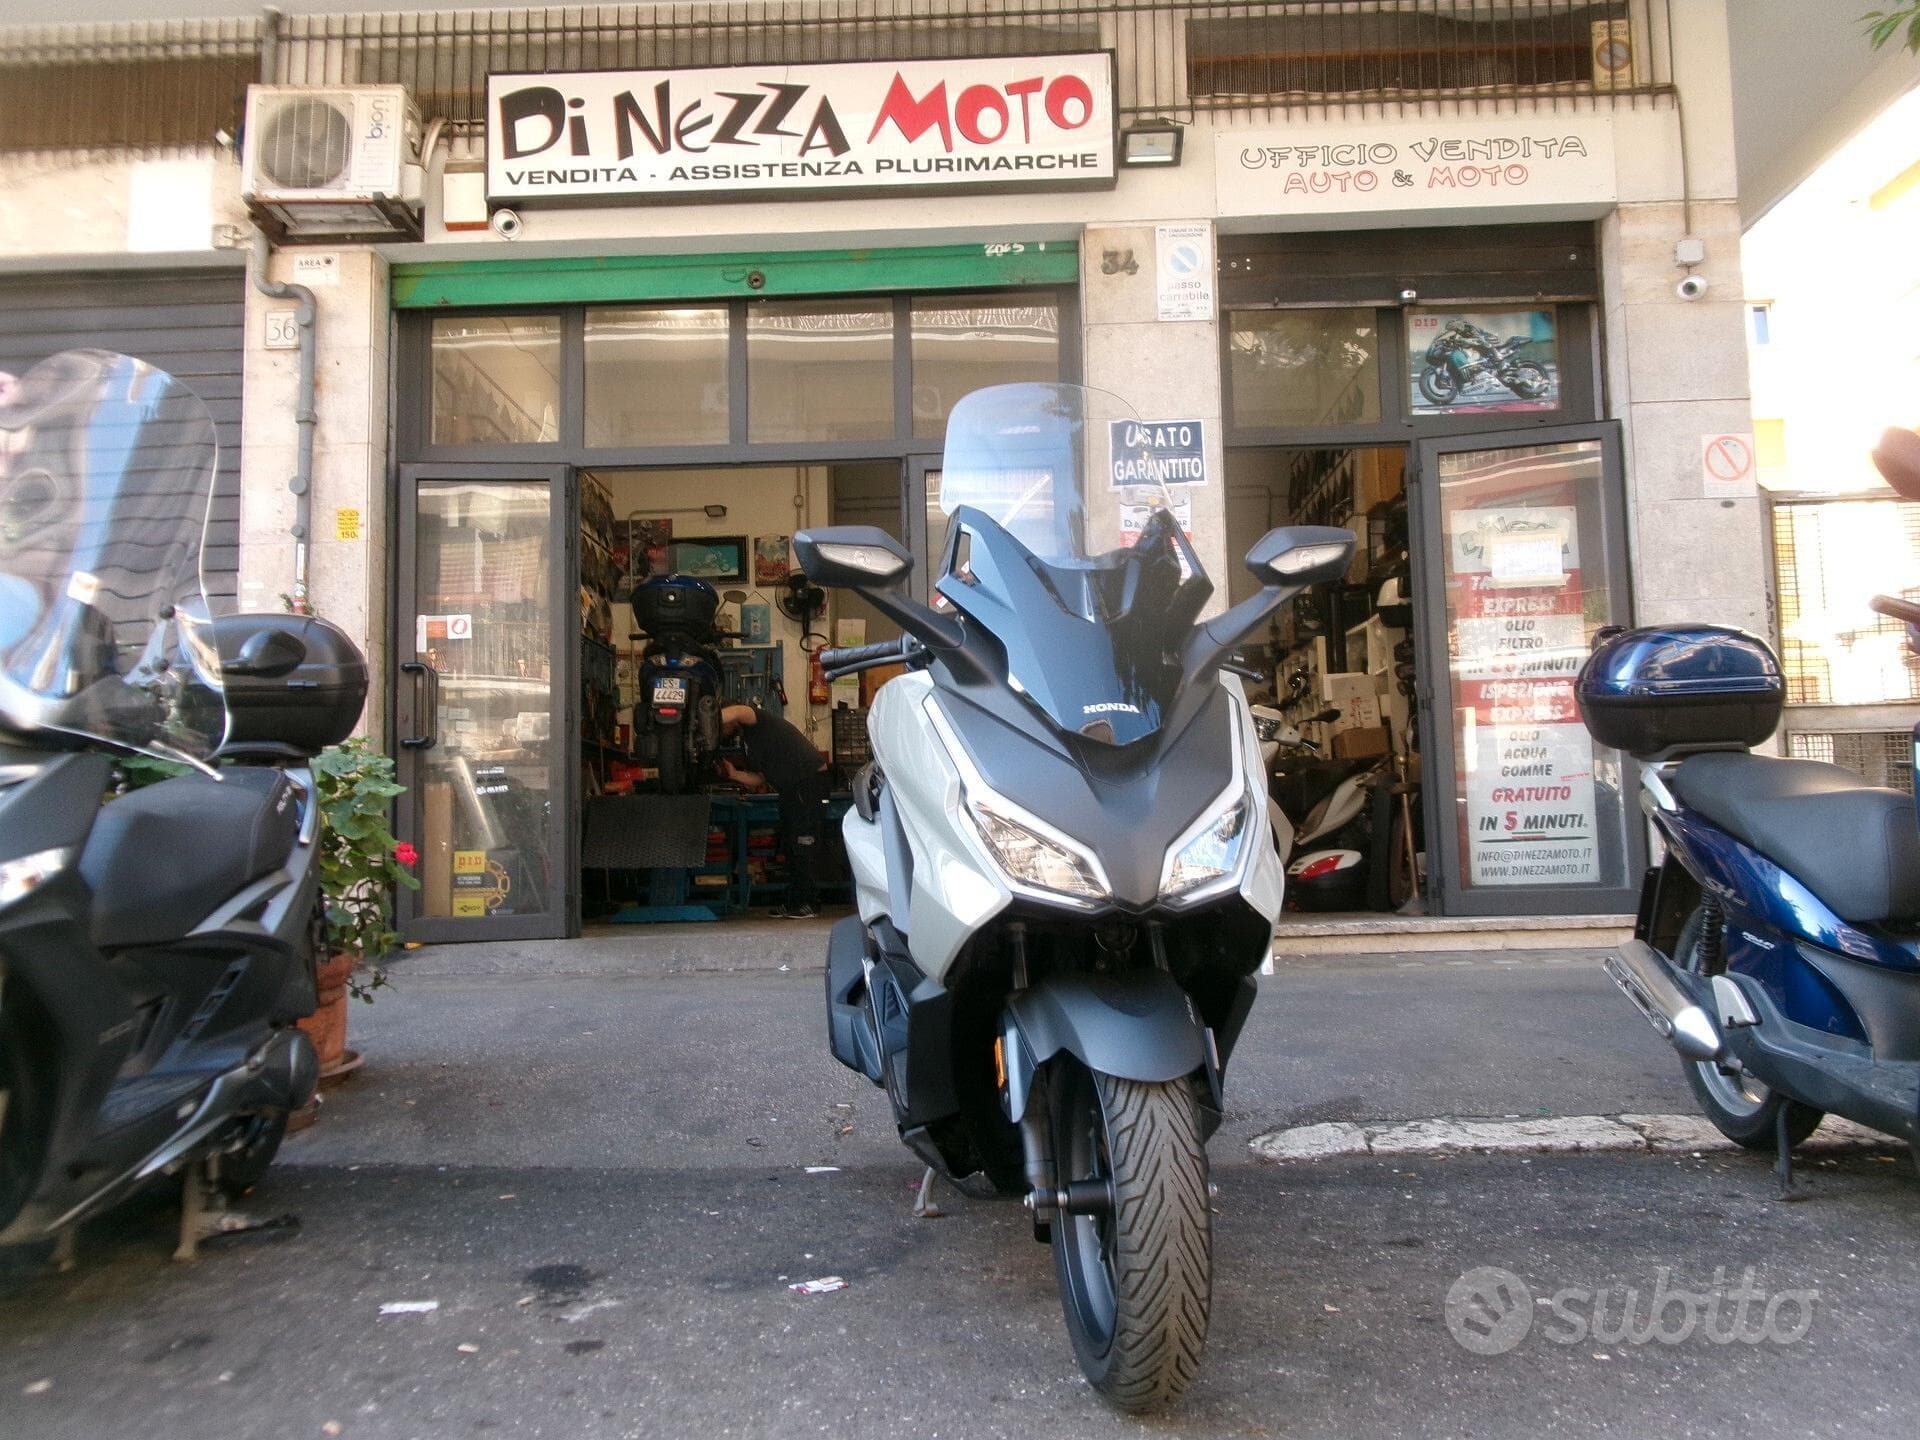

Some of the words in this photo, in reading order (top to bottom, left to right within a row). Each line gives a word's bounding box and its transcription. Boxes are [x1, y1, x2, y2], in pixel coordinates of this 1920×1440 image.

[500, 85, 590, 160] Di
[867, 70, 1094, 153] MOTO
[1240, 142, 1398, 170] UFFICIO
[1409, 136, 1588, 163] VENDITA
[506, 167, 637, 187] VENDITA
[668, 158, 865, 182] ASSISTENZA
[875, 152, 1099, 175] PLURIMARCHE
[1284, 170, 1379, 194] AUTO
[1392, 169, 1415, 188] &
[1428, 163, 1529, 189] MOTO
[1167, 280, 1201, 293] passo
[1159, 291, 1210, 302] carrabile
[267, 317, 296, 341] 36
[1125, 425, 1192, 448] USATO
[1113, 458, 1203, 481] GARANTITO
[1505, 620, 1536, 633] OLIO
[1498, 636, 1544, 649] FILTRO
[1521, 656, 1578, 673] MINUTI
[1083, 702, 1140, 714] HONDA
[1509, 730, 1541, 742] OLIO
[1504, 747, 1548, 760] ACQUA
[1501, 764, 1554, 777] GOMME
[1492, 785, 1572, 803] GRATUITO
[1479, 816, 1499, 831] IN
[1503, 811, 1518, 831] 5
[1477, 848, 1592, 863] INFO@DINEZZAMOTO.IT
[1481, 864, 1591, 877] WWW.DINEZZAMOTO.IT
